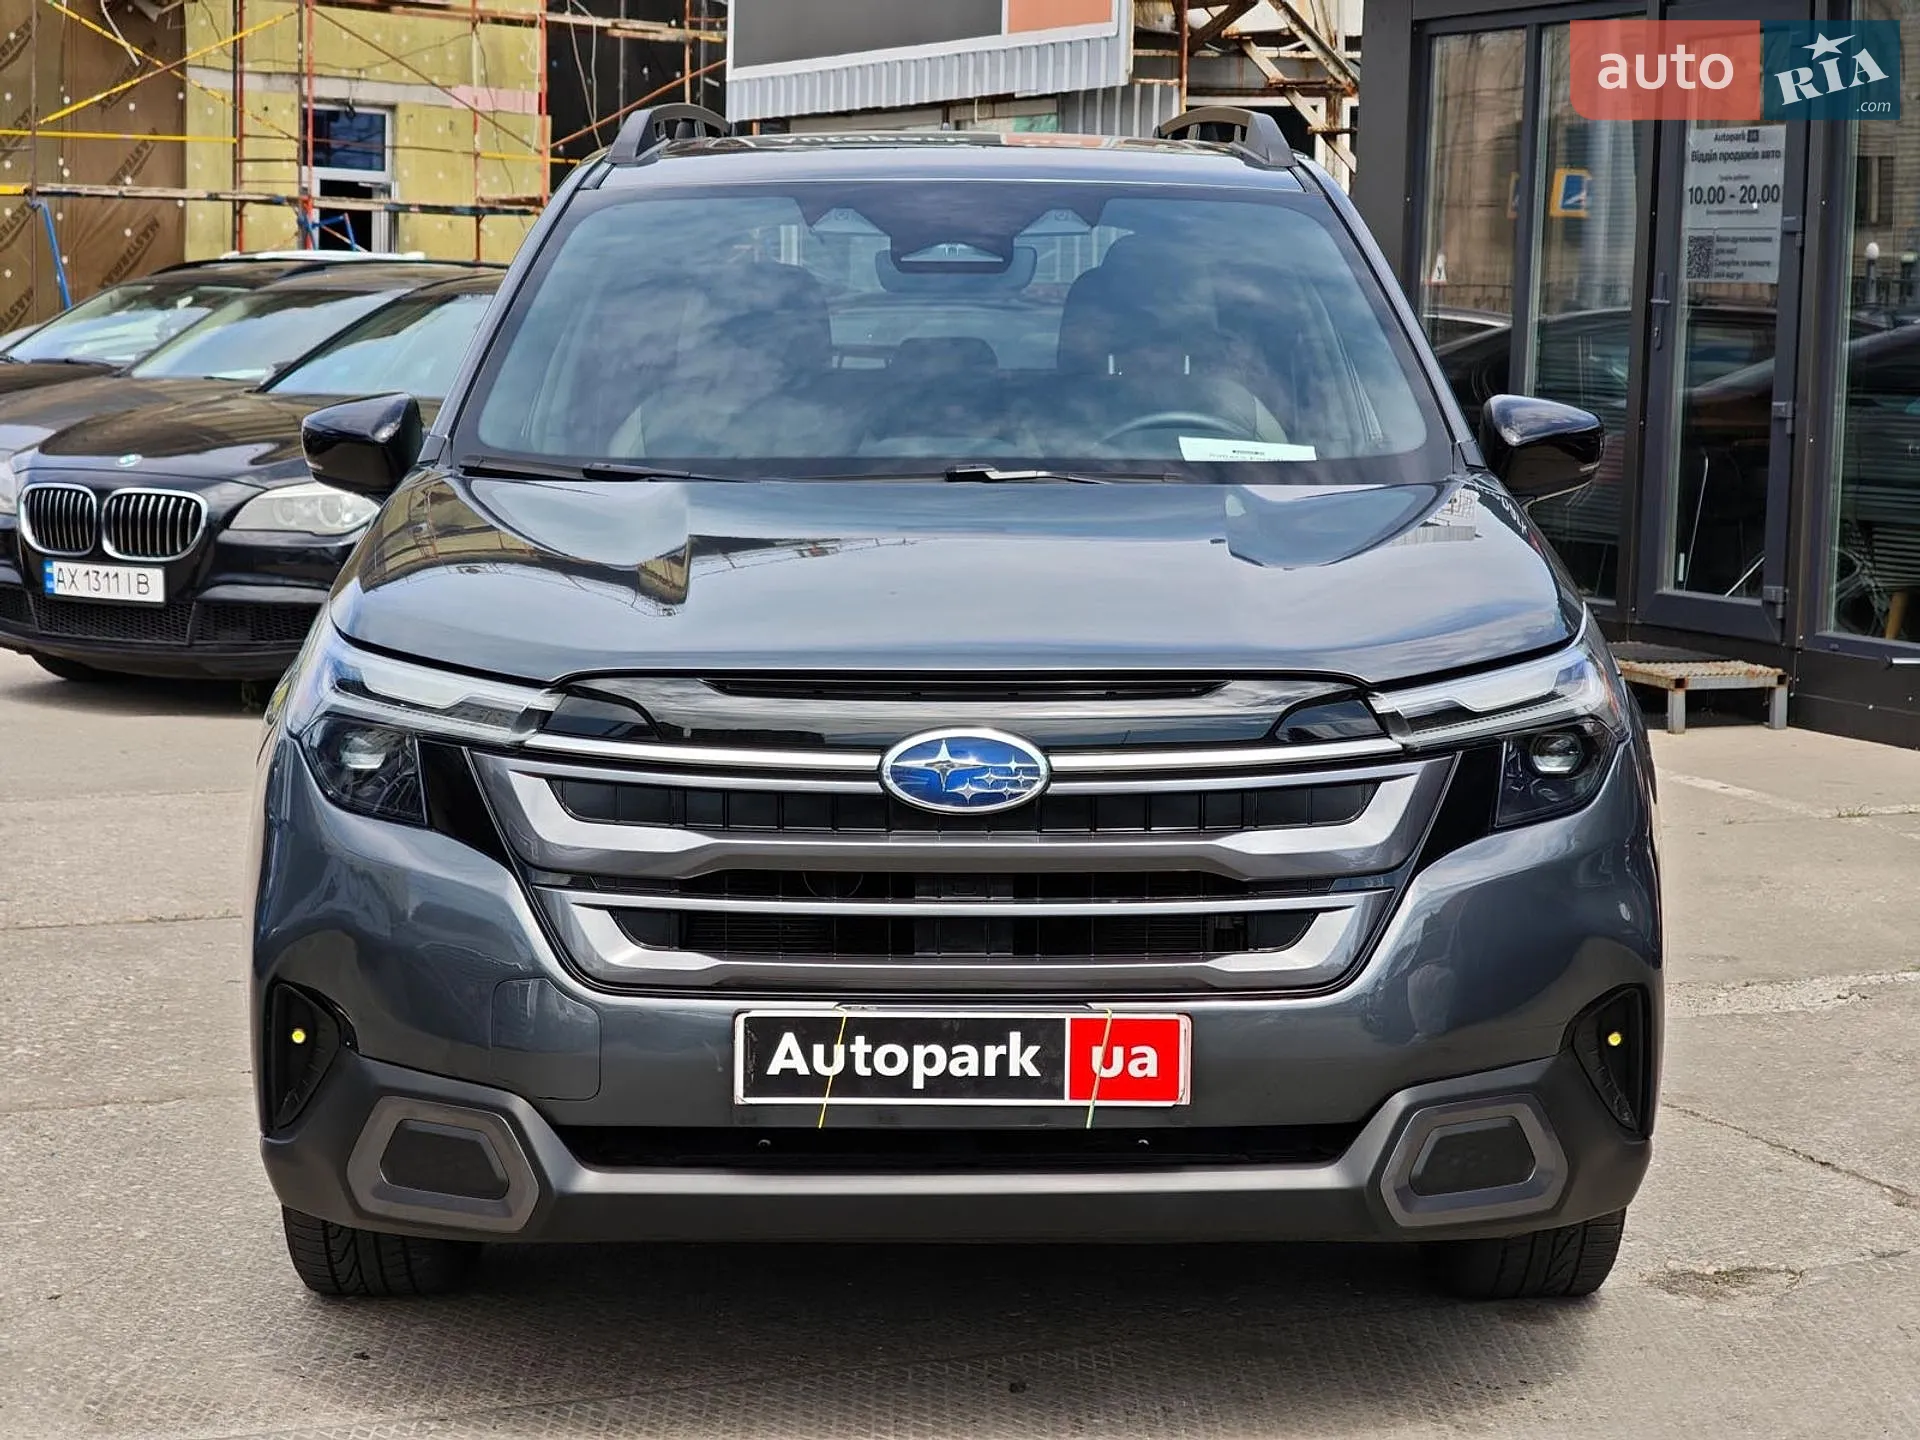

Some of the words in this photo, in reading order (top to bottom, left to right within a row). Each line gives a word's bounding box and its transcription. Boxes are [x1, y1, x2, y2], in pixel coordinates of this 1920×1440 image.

[1691, 149, 1718, 164] Відділ
[1761, 150, 1781, 160] авто
[1688, 186, 1726, 205] 10.00
[1739, 184, 1781, 204] 20.00
[56, 567, 79, 591] AX
[83, 569, 120, 594] 1311
[766, 1031, 1041, 1090] Autopark
[1091, 1044, 1159, 1078] ua
